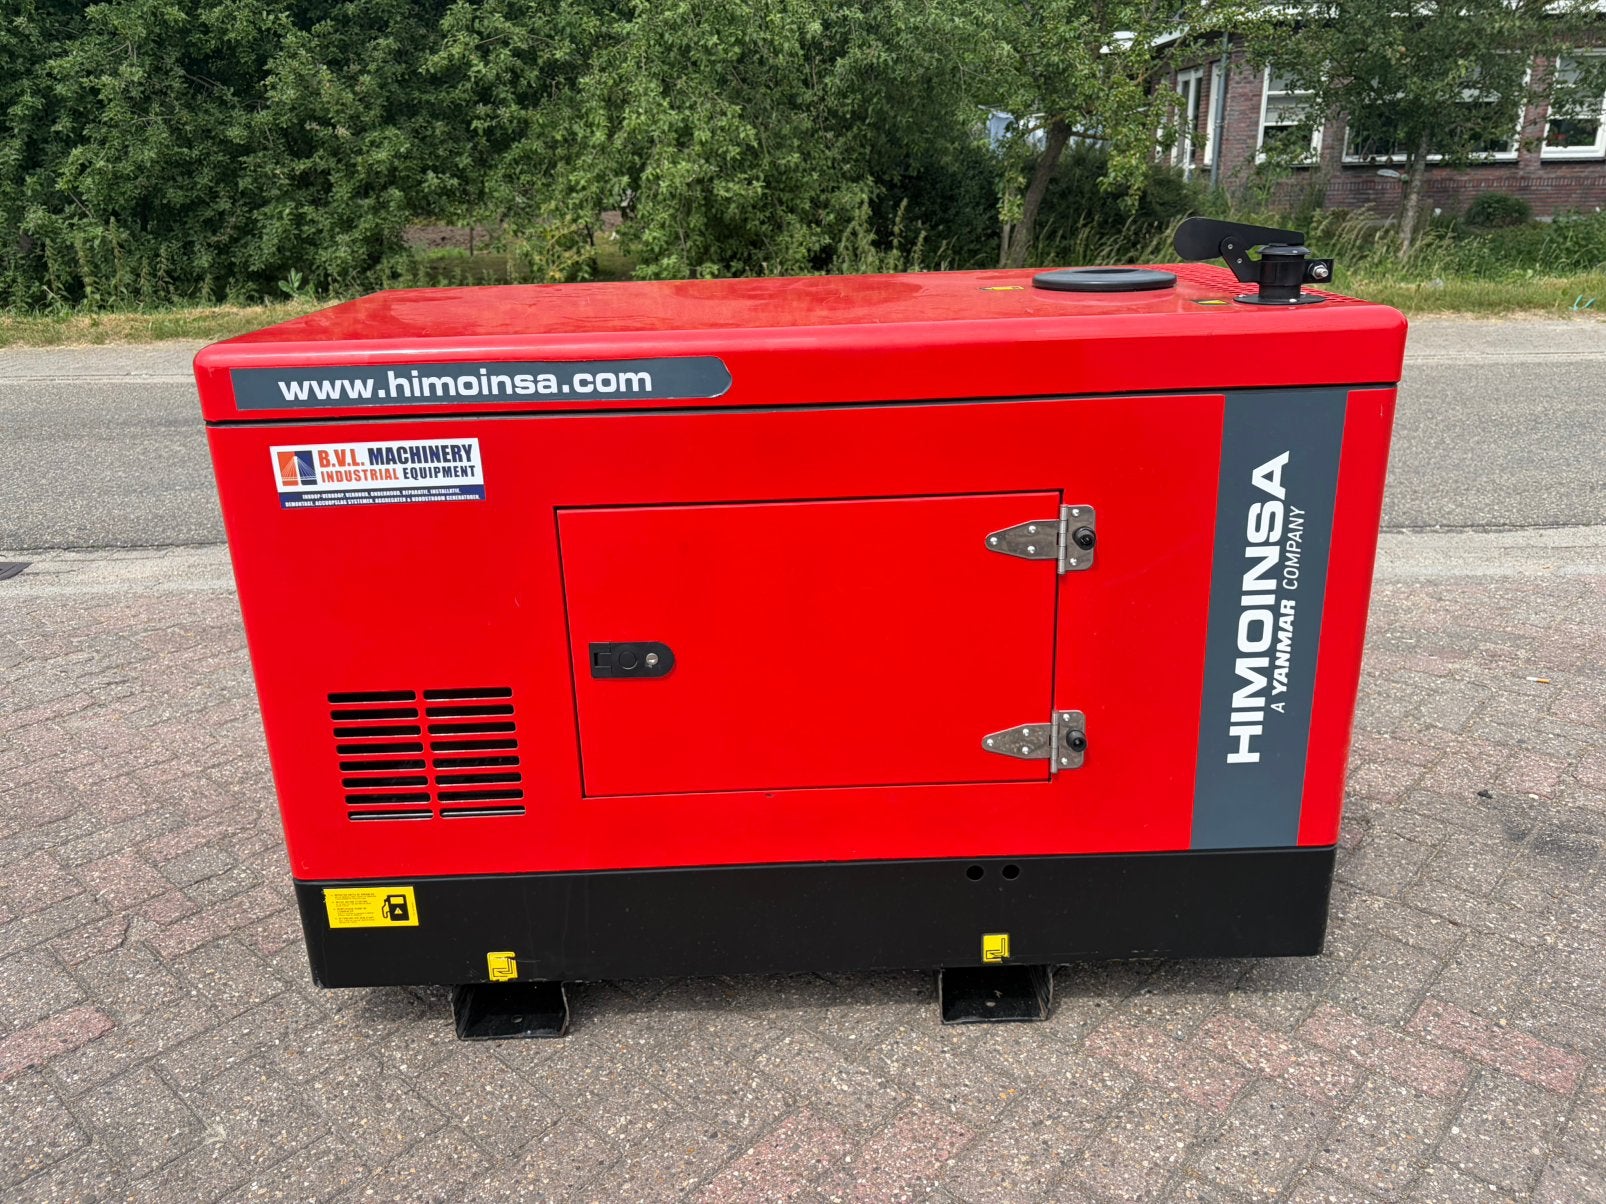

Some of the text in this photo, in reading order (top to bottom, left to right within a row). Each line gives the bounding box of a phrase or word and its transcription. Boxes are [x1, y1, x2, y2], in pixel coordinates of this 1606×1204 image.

[278, 368, 652, 401] www.himoinsa.com
[317, 444, 473, 468] B.V.L. MACHINERY
[321, 465, 476, 484] INDUSTRIAL EQUIPMENT
[1226, 450, 1290, 764] HIMOINSA
[1270, 506, 1306, 713] A YANMAR COMPANY
